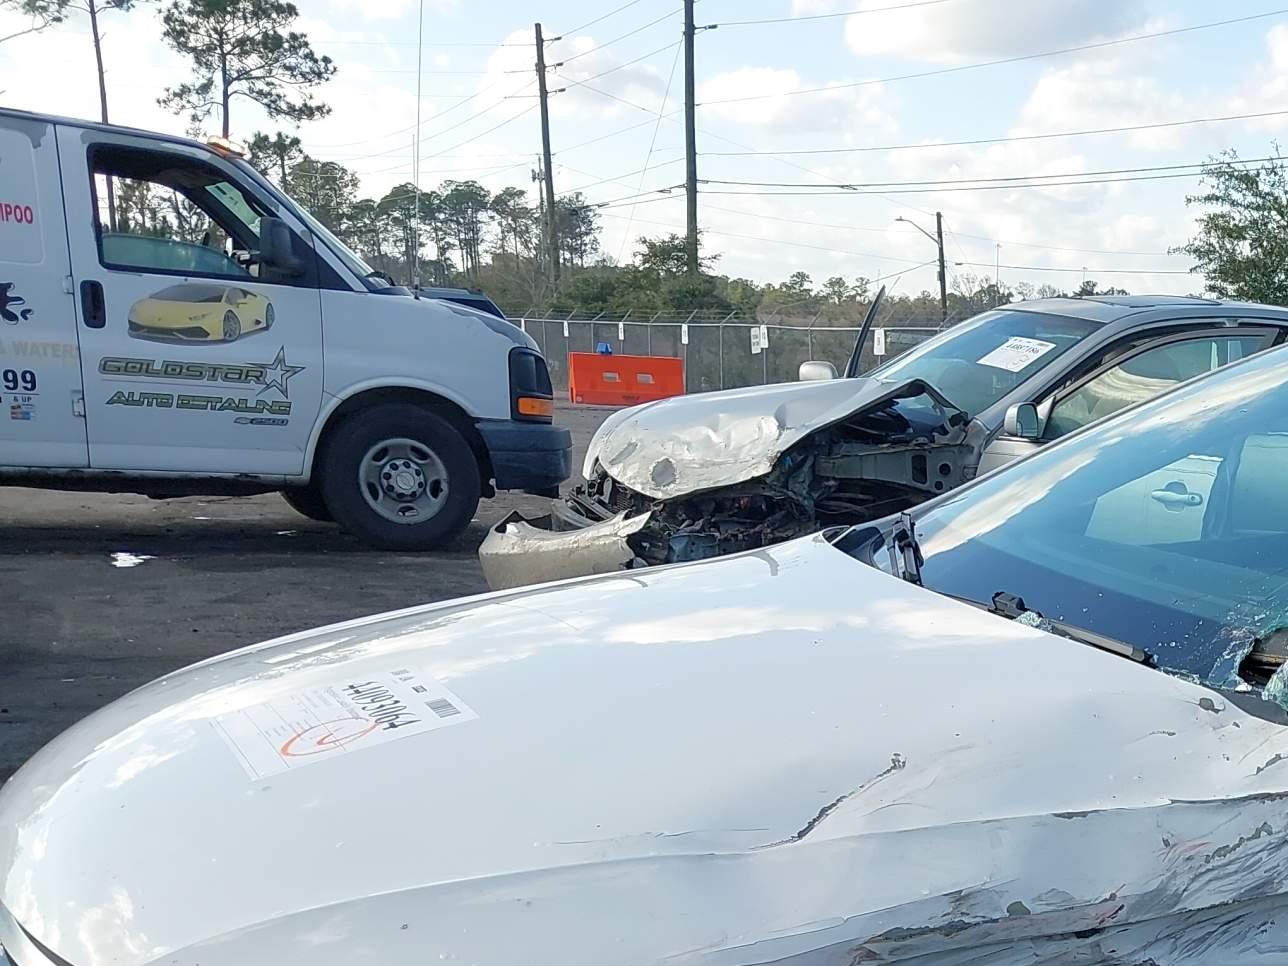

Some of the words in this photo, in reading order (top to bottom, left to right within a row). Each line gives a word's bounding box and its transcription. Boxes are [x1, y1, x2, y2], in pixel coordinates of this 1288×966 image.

[105, 391, 173, 408] AUTO
[176, 394, 292, 416] DETAILING
[341, 681, 421, 730] 44093064
